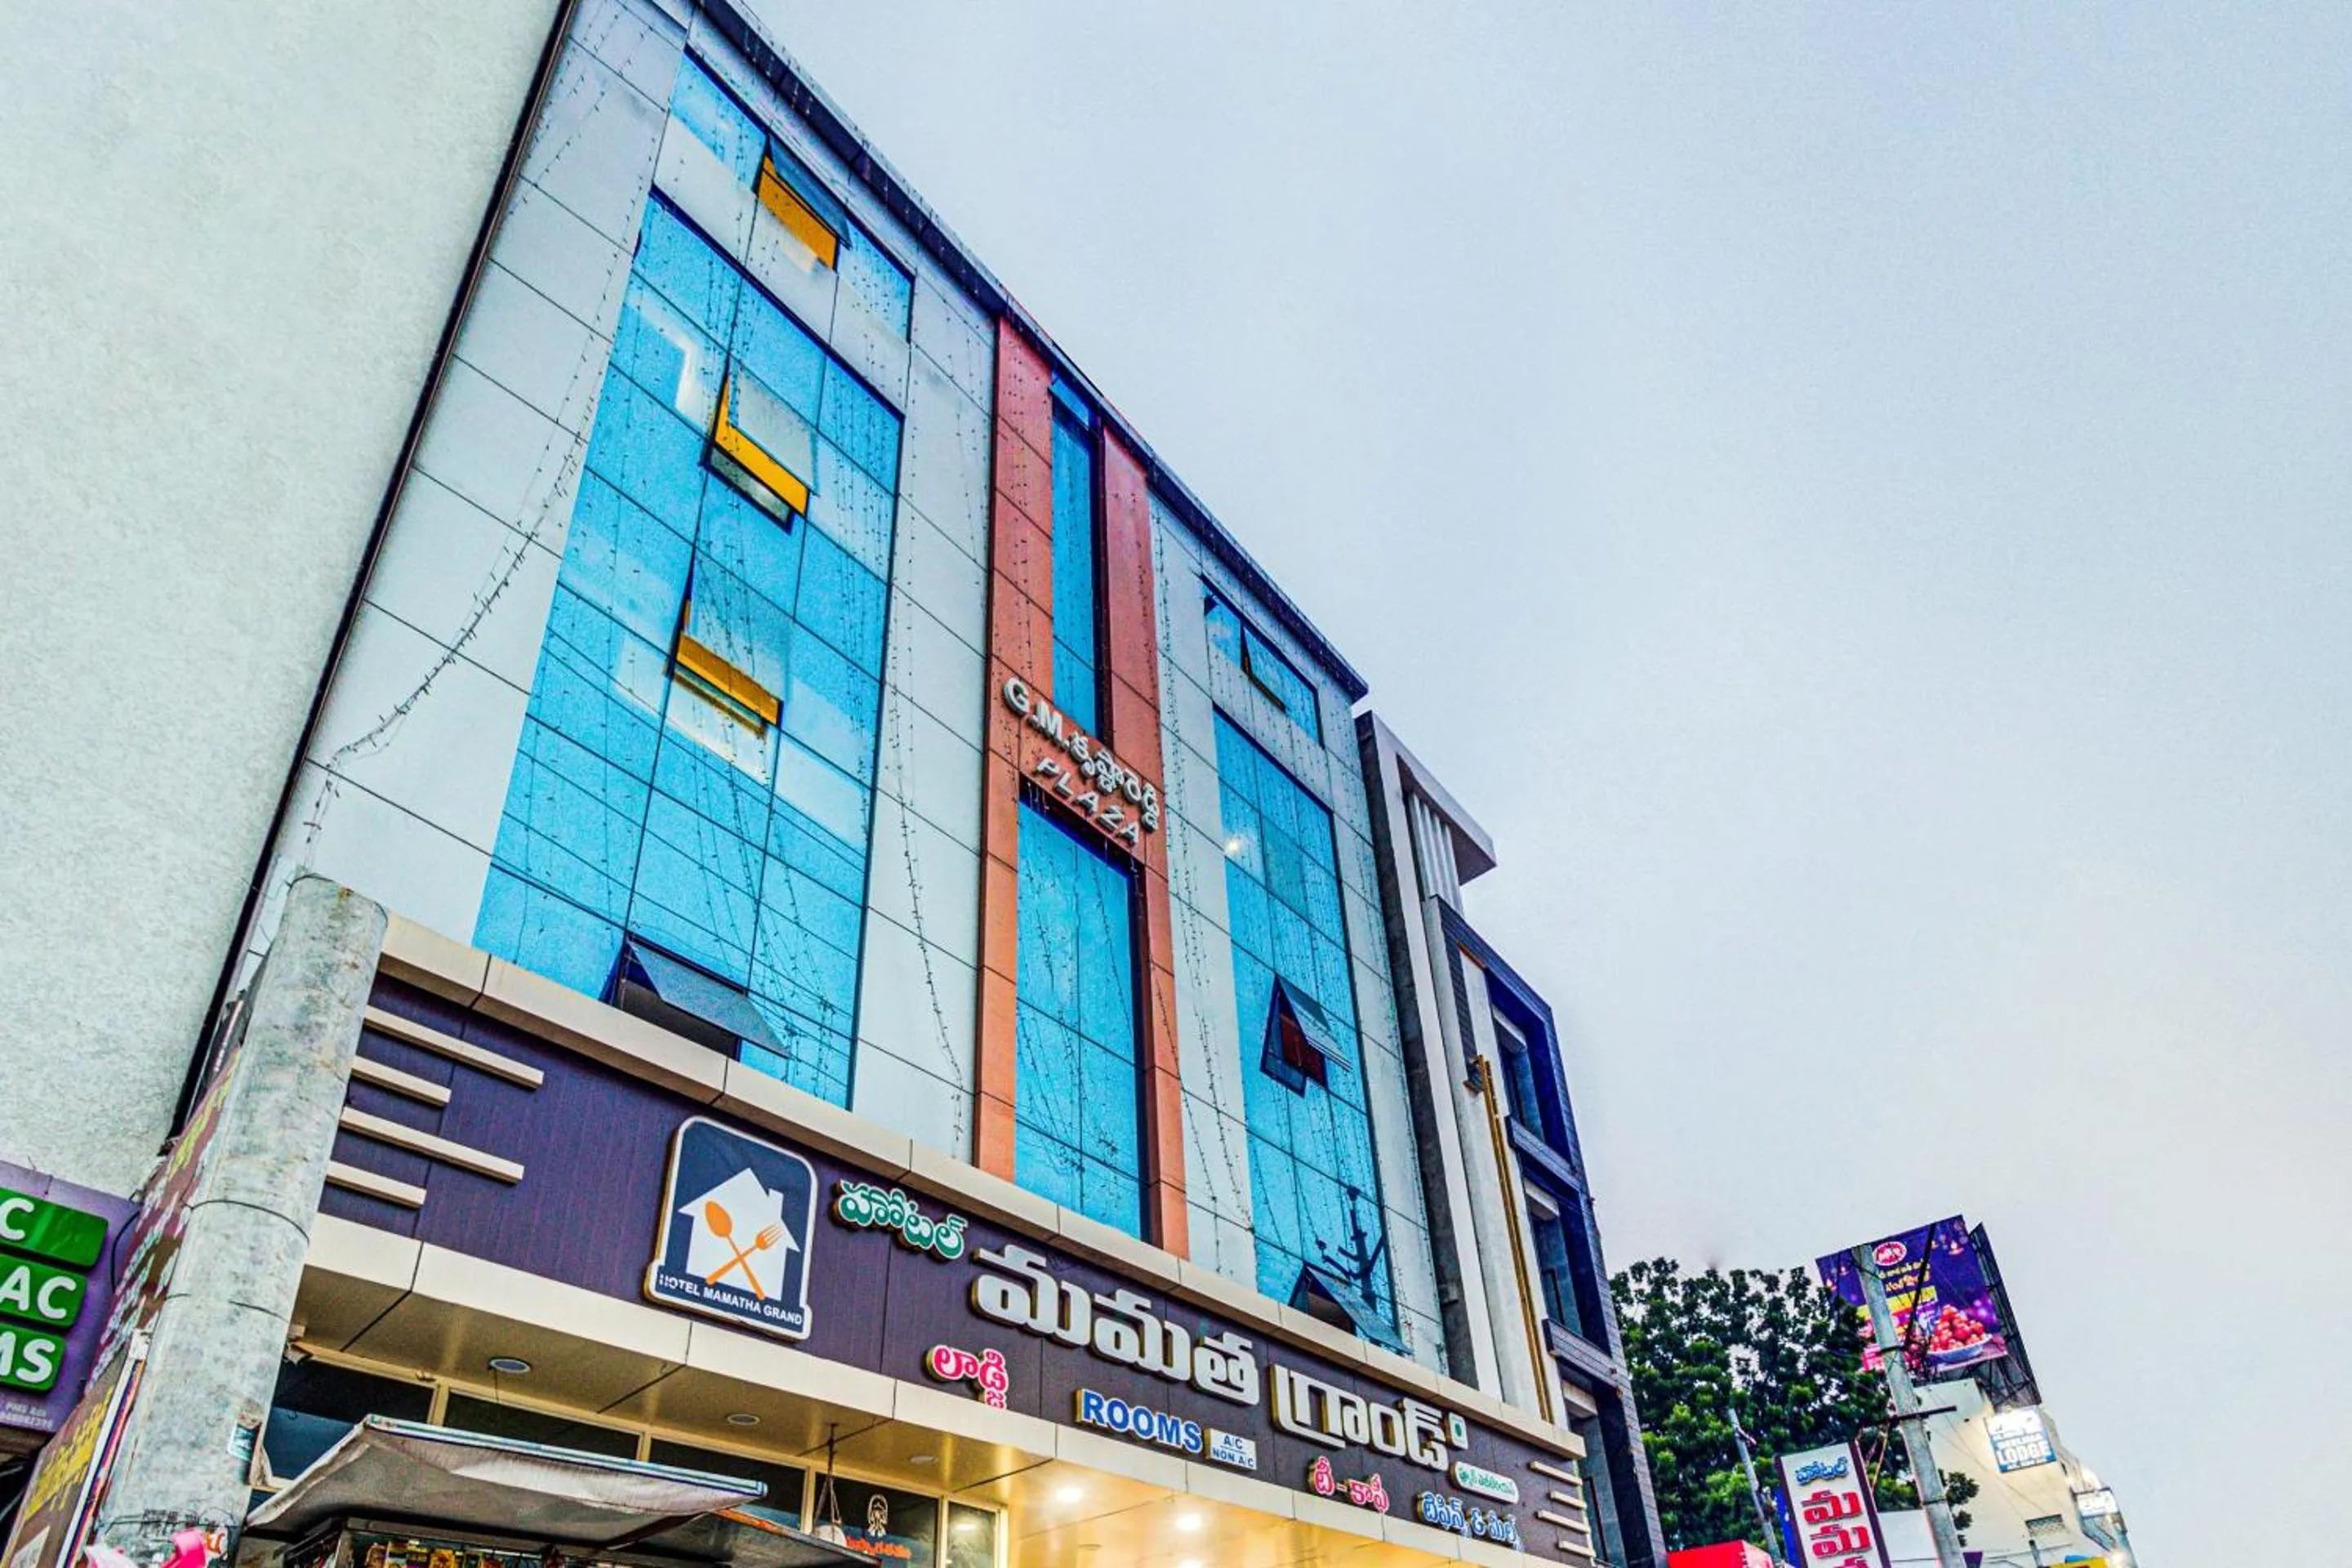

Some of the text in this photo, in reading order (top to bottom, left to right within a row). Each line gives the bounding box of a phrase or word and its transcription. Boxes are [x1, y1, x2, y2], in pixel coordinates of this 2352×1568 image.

[1035, 757, 1140, 846] PLAZA
[838, 1179, 969, 1260] హోటల్
[658, 1273, 803, 1325] HOTEL MAMATHA GRAND
[976, 1244, 1450, 1472] మమత గ్రాండ్
[1082, 1388, 1204, 1454] ROOMS
[1211, 1446, 1235, 1462] NON
